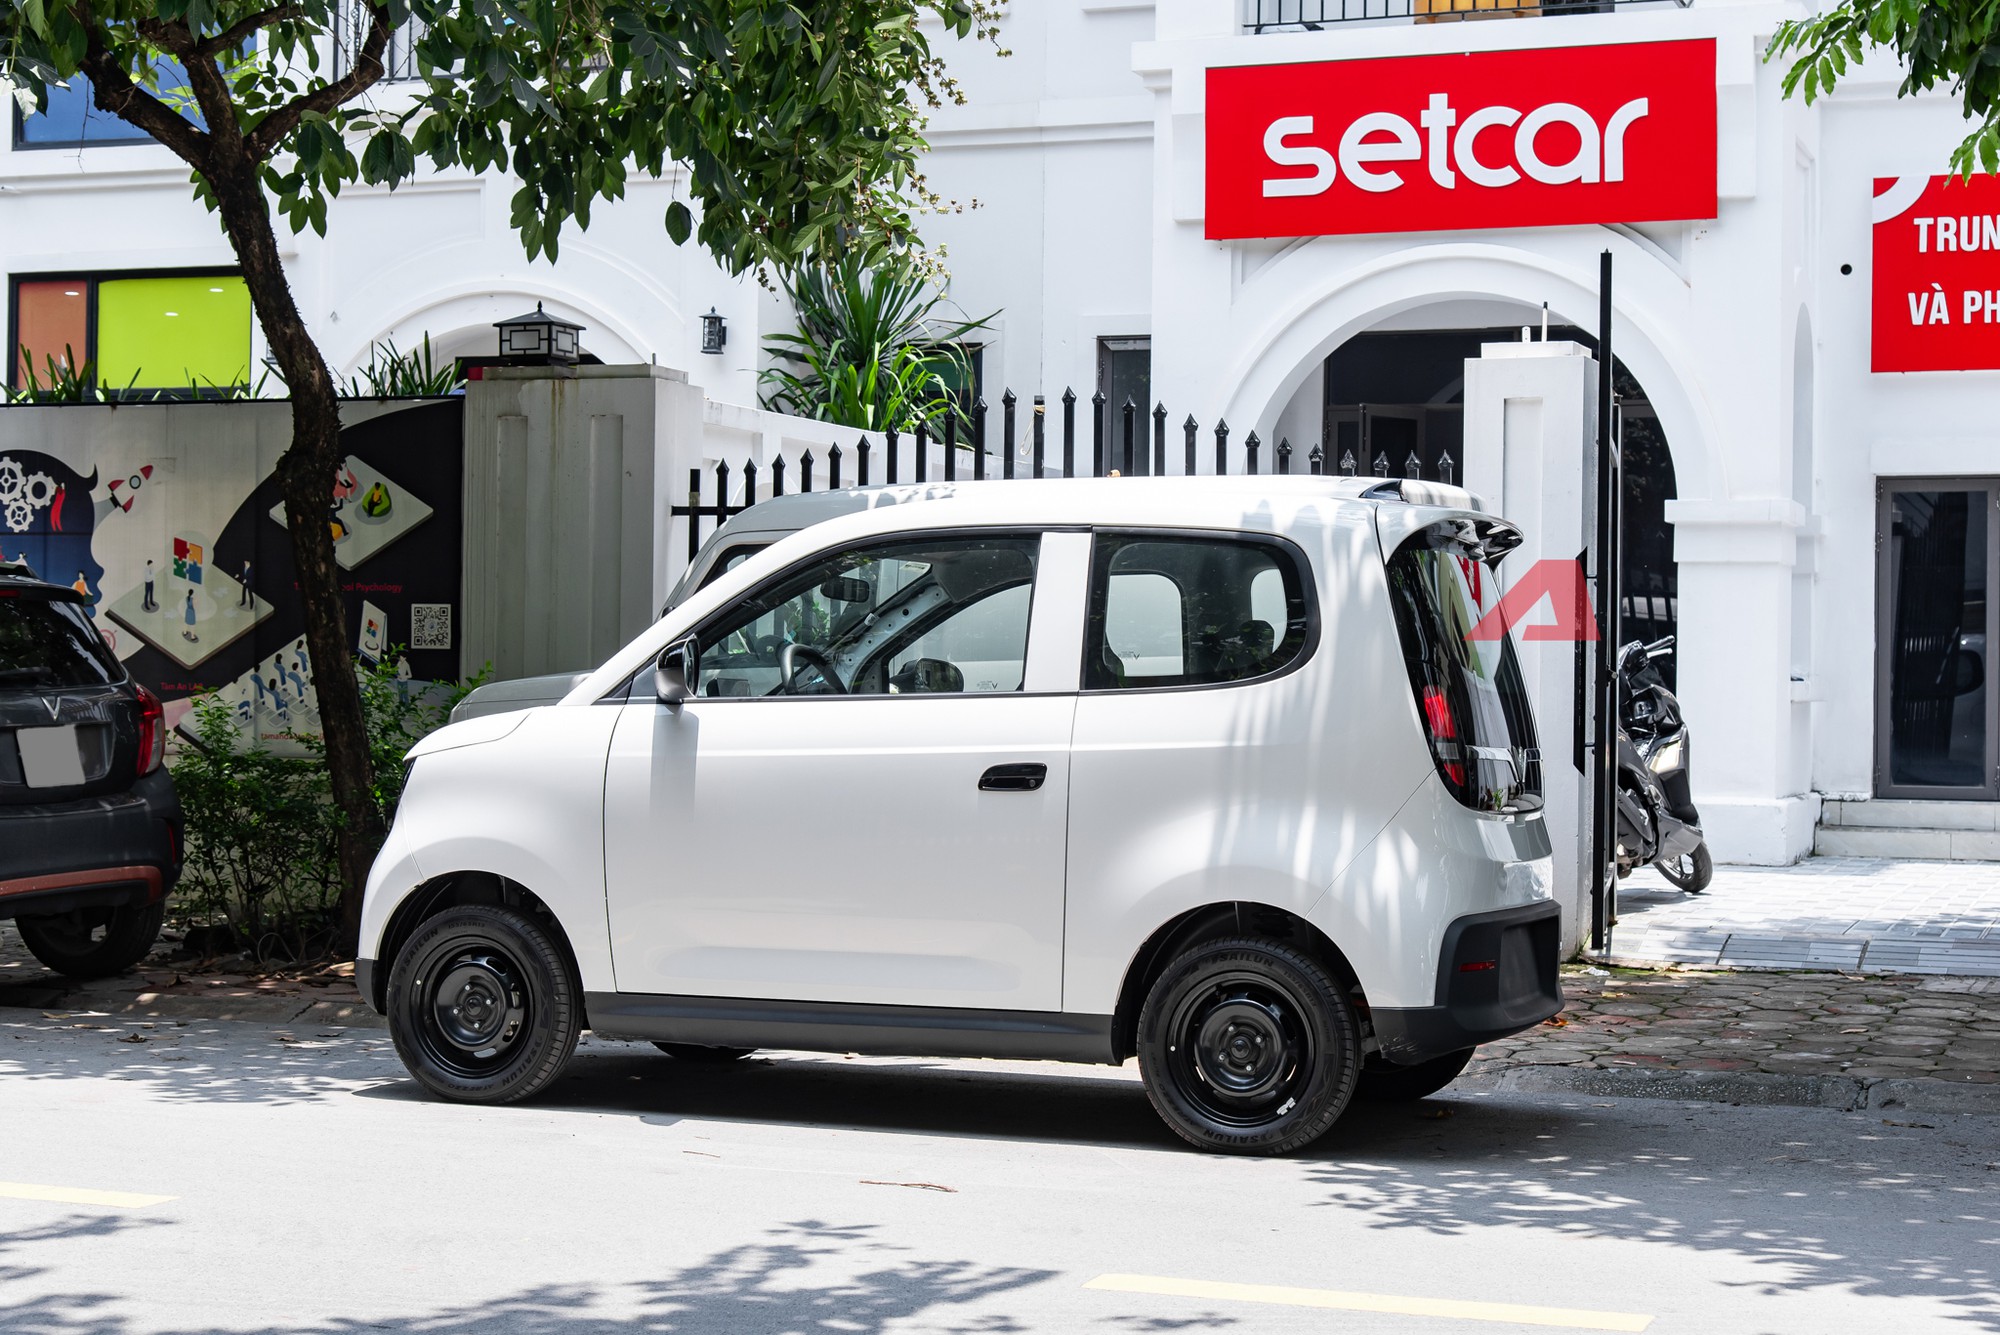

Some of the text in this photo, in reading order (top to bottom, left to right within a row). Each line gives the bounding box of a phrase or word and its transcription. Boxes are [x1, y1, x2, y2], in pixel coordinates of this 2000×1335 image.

[1262, 92, 1649, 198] setcar
[1913, 214, 2000, 253] TRUN
[1907, 282, 2000, 326] VÀ PH
[355, 582, 402, 593] Psychology
[403, 927, 439, 968] SAILUN
[1219, 952, 1274, 968] SAILUN
[501, 1047, 538, 1087] SAILUN
[1203, 1129, 1259, 1144] SAILUN
